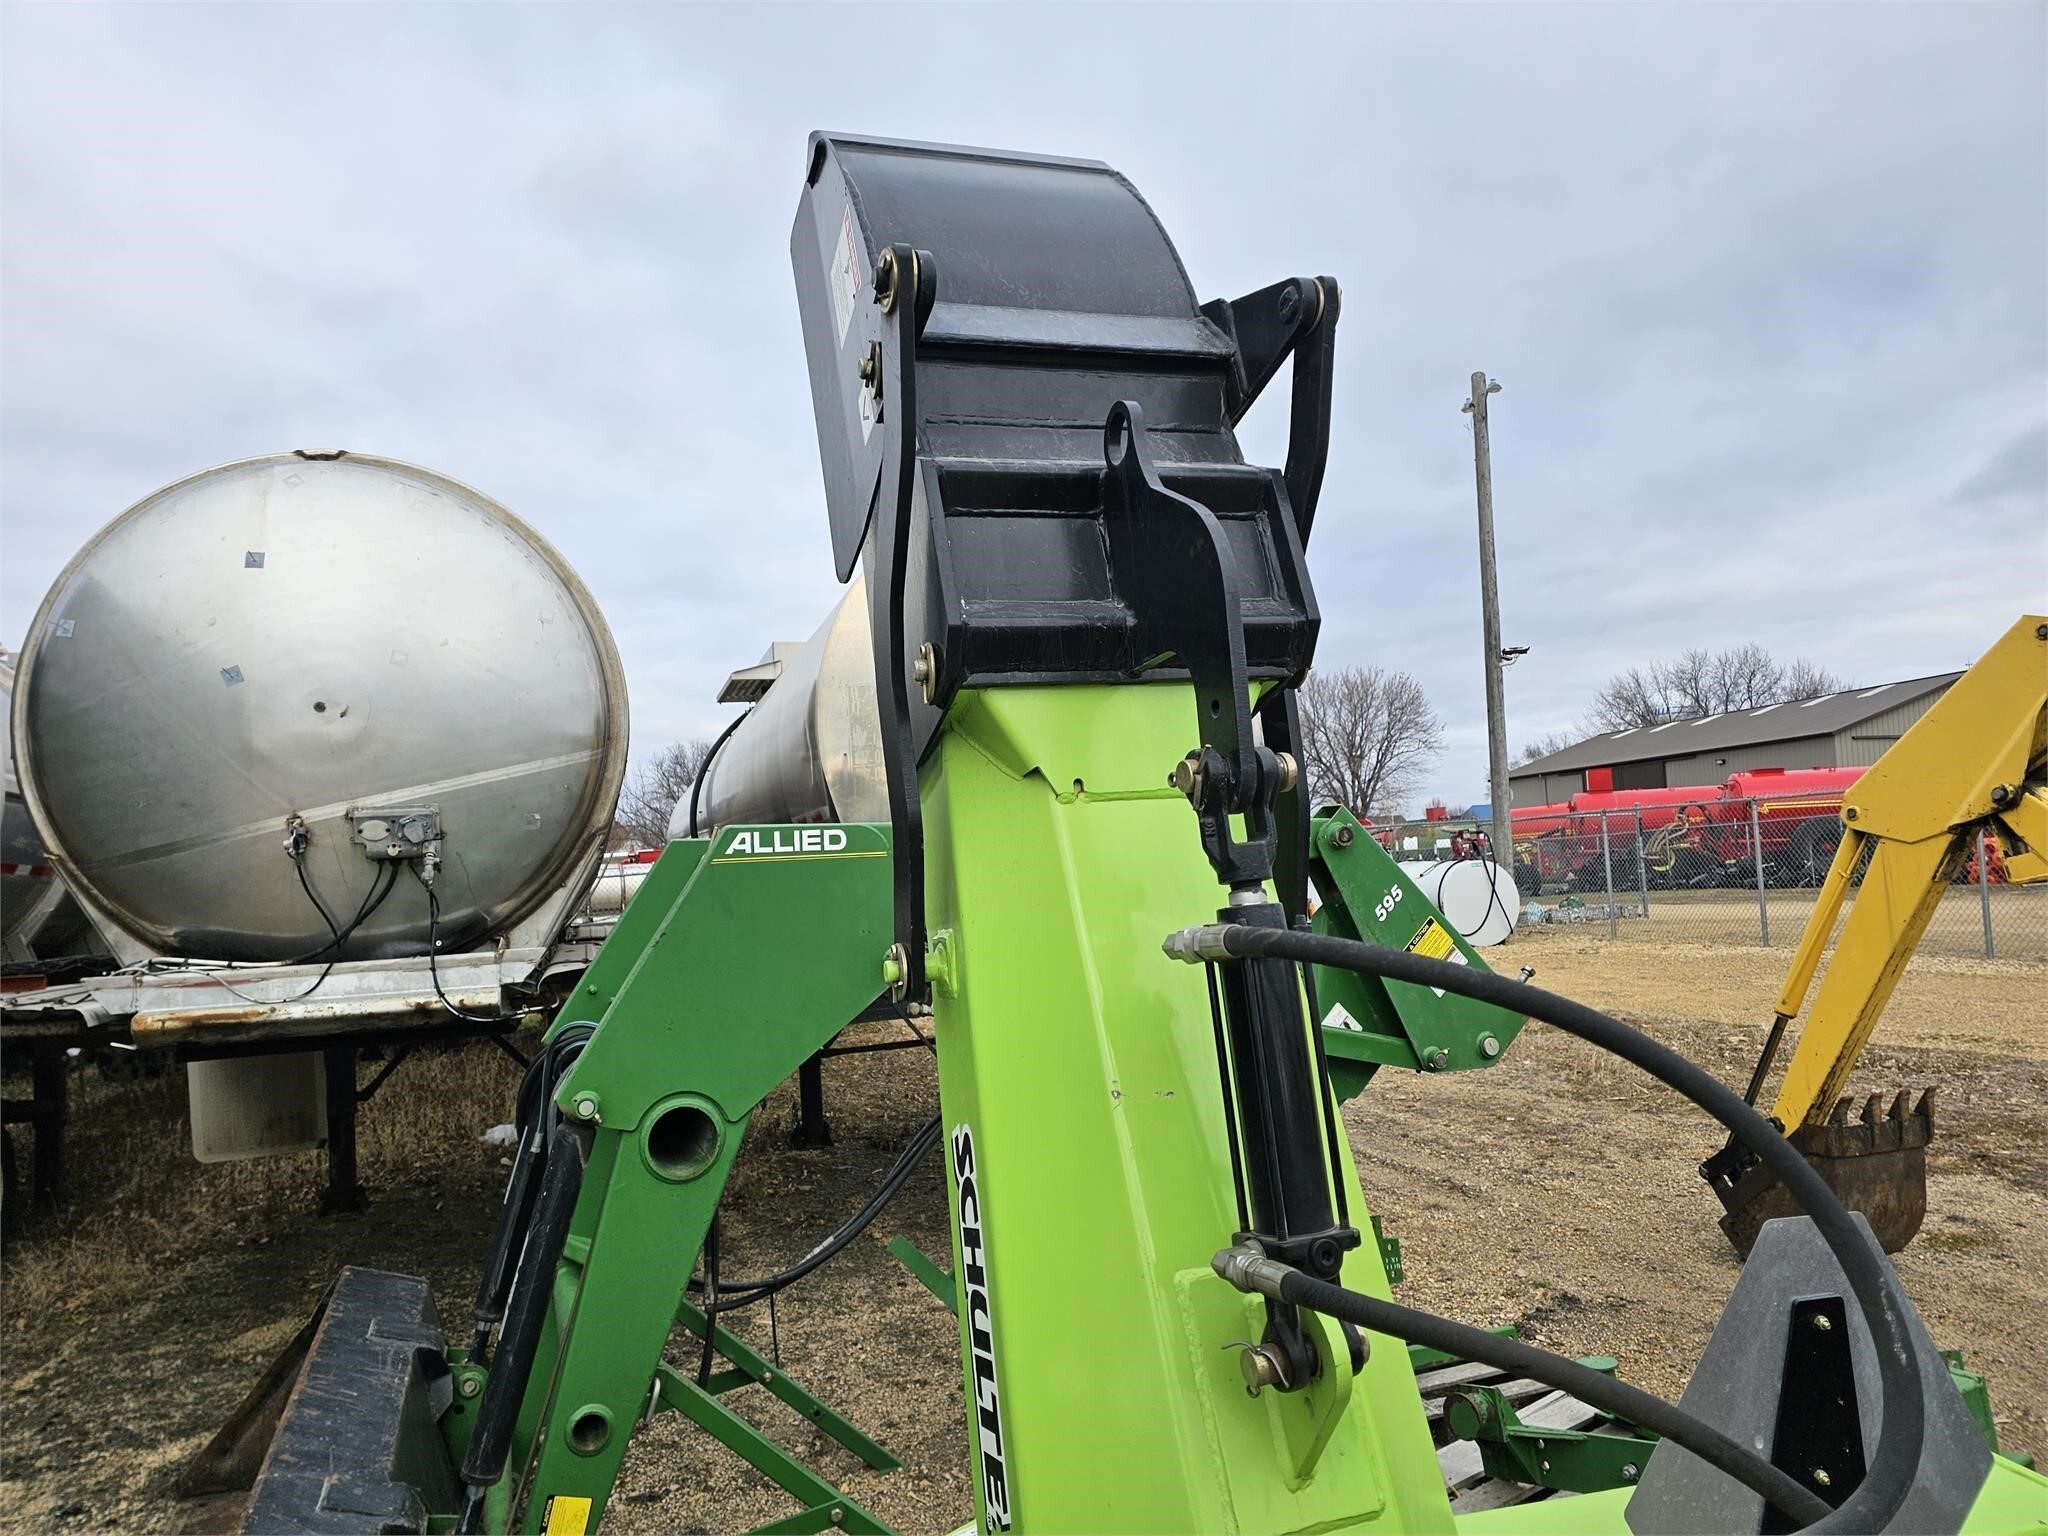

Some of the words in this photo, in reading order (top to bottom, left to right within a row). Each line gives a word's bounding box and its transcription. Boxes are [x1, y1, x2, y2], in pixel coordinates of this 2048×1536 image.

[725, 829, 847, 854] ALLIED
[1375, 884, 1402, 921] 595
[1412, 924, 1430, 945] CAUTION
[951, 1124, 1011, 1534] SCHULTE
